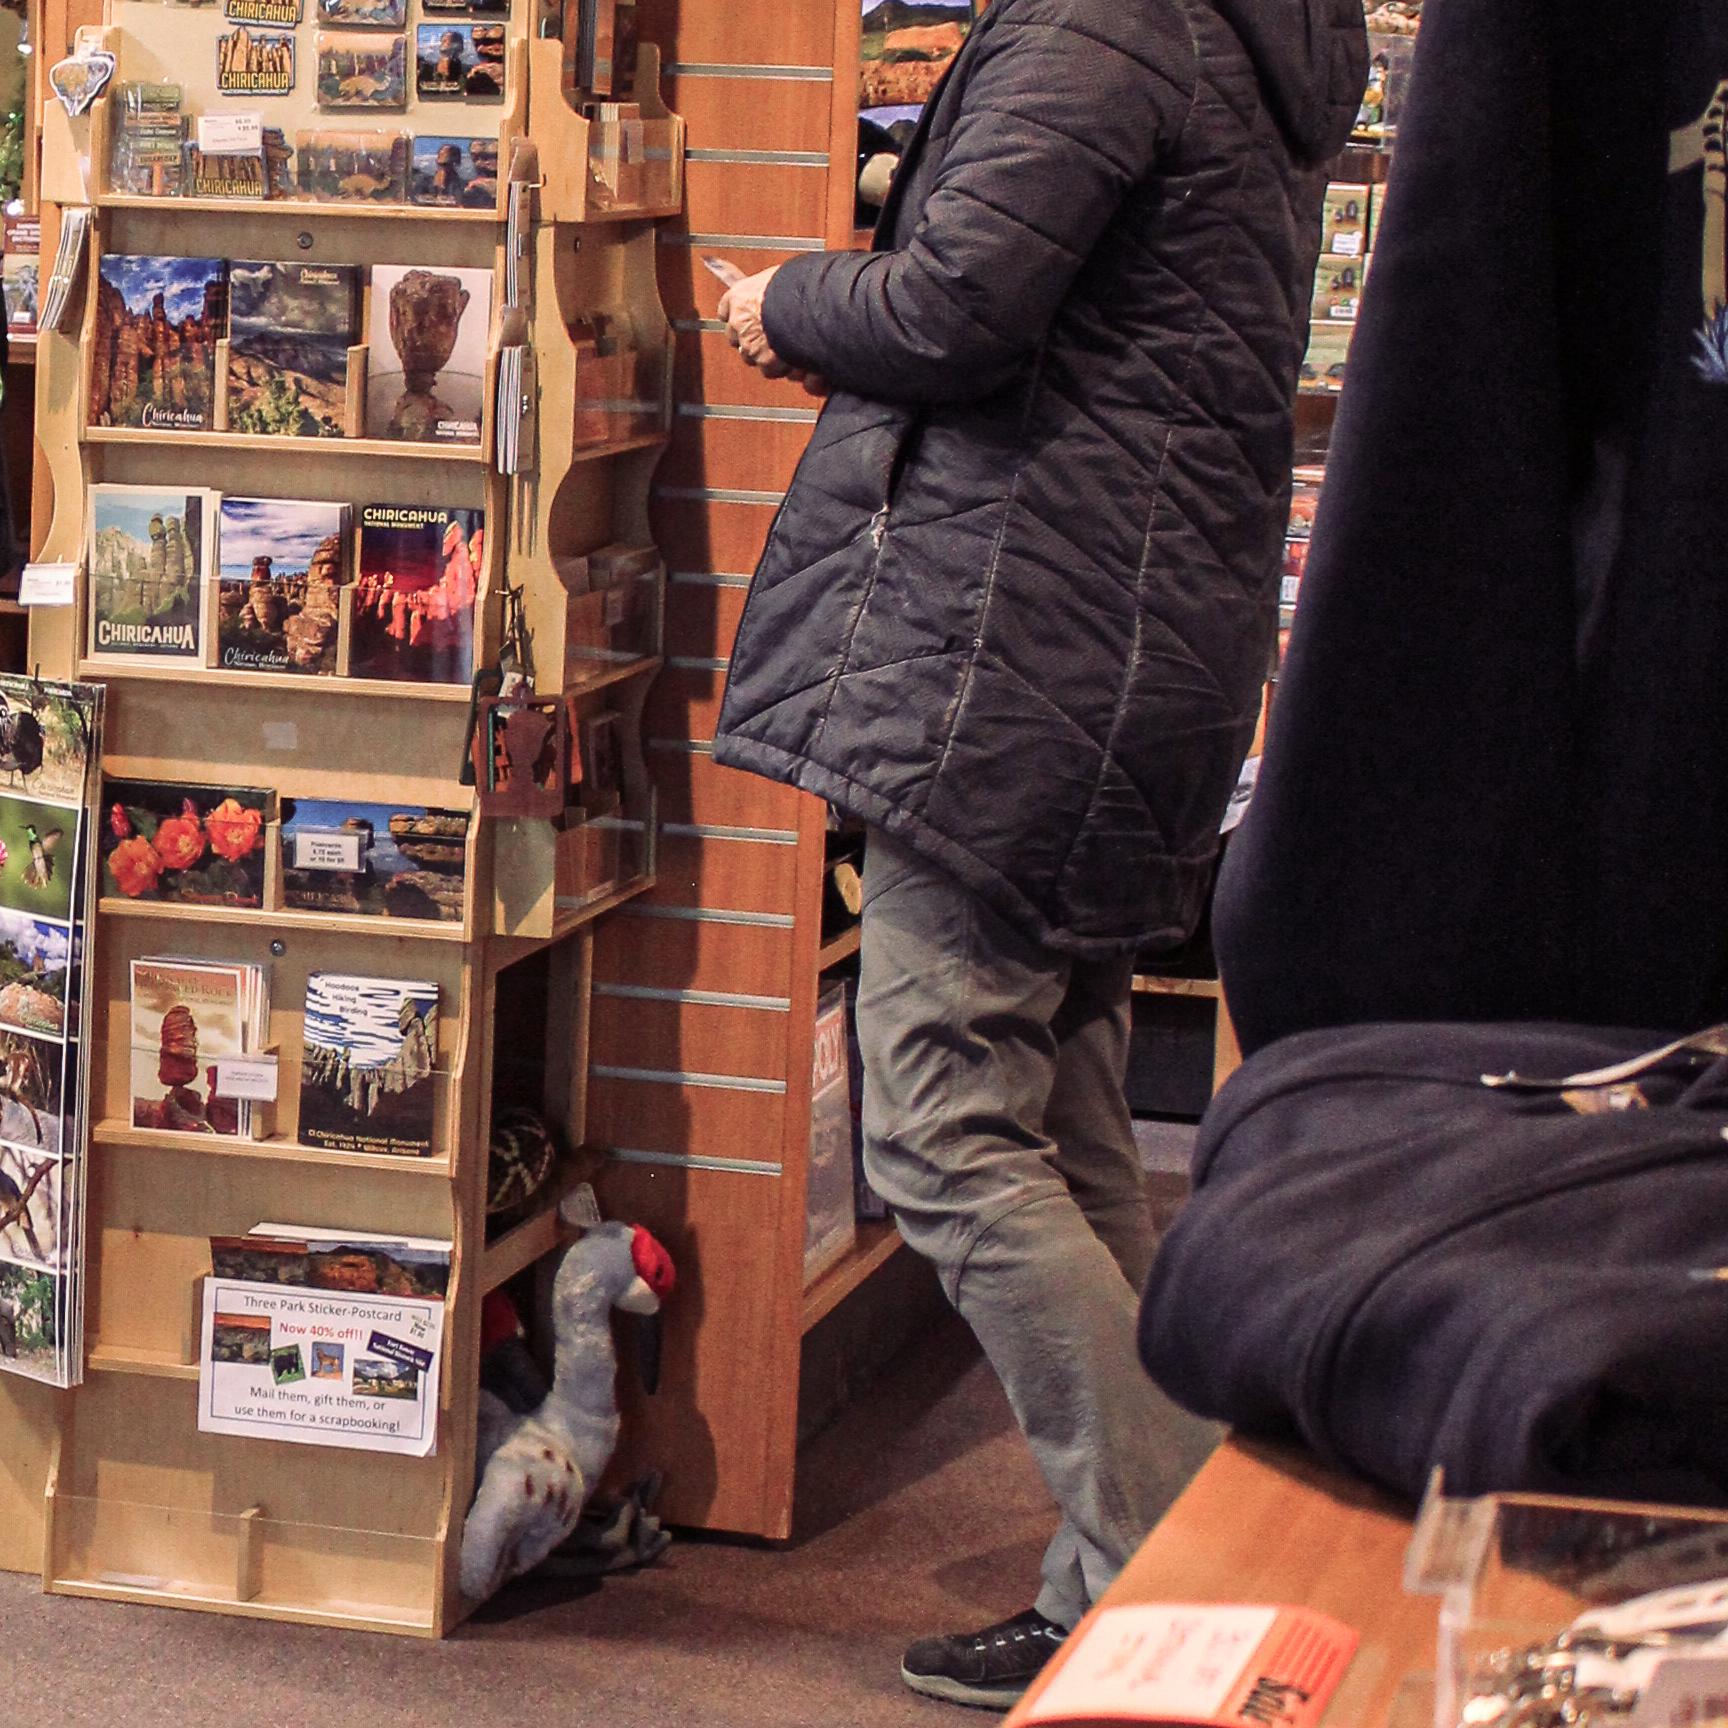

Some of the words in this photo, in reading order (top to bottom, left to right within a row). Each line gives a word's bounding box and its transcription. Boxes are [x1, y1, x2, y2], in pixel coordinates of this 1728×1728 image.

[228, 0, 297, 21] CHIRICAHUA
[221, 73, 289, 89] CHIRICAHUA
[196, 179, 263, 195] CHIRICAHUA
[142, 402, 204, 426] Chiricahua
[363, 508, 447, 525] CHIRICAHUA
[97, 619, 196, 651] CHIRICAHUA
[224, 646, 290, 666] Chiricahua
[332, 994, 357, 1004] Hiking
[339, 1005, 368, 1016] Birding
[243, 1295, 277, 1309] Three
[279, 1299, 305, 1313] Park
[308, 1302, 401, 1322] Sticker-Postcard
[279, 1322, 306, 1335] Now
[309, 1325, 334, 1338] 40%
[337, 1327, 363, 1340] off!!
[249, 1386, 275, 1399] Mail
[278, 1388, 311, 1405] them,
[314, 1392, 333, 1408] gift
[335, 1395, 370, 1410] them,
[373, 1401, 385, 1411] or
[234, 1405, 254, 1416] use
[257, 1405, 286, 1419] them
[290, 1409, 307, 1421] for
[309, 1414, 316, 1422] a
[319, 1413, 401, 1433] scrapbooking!
